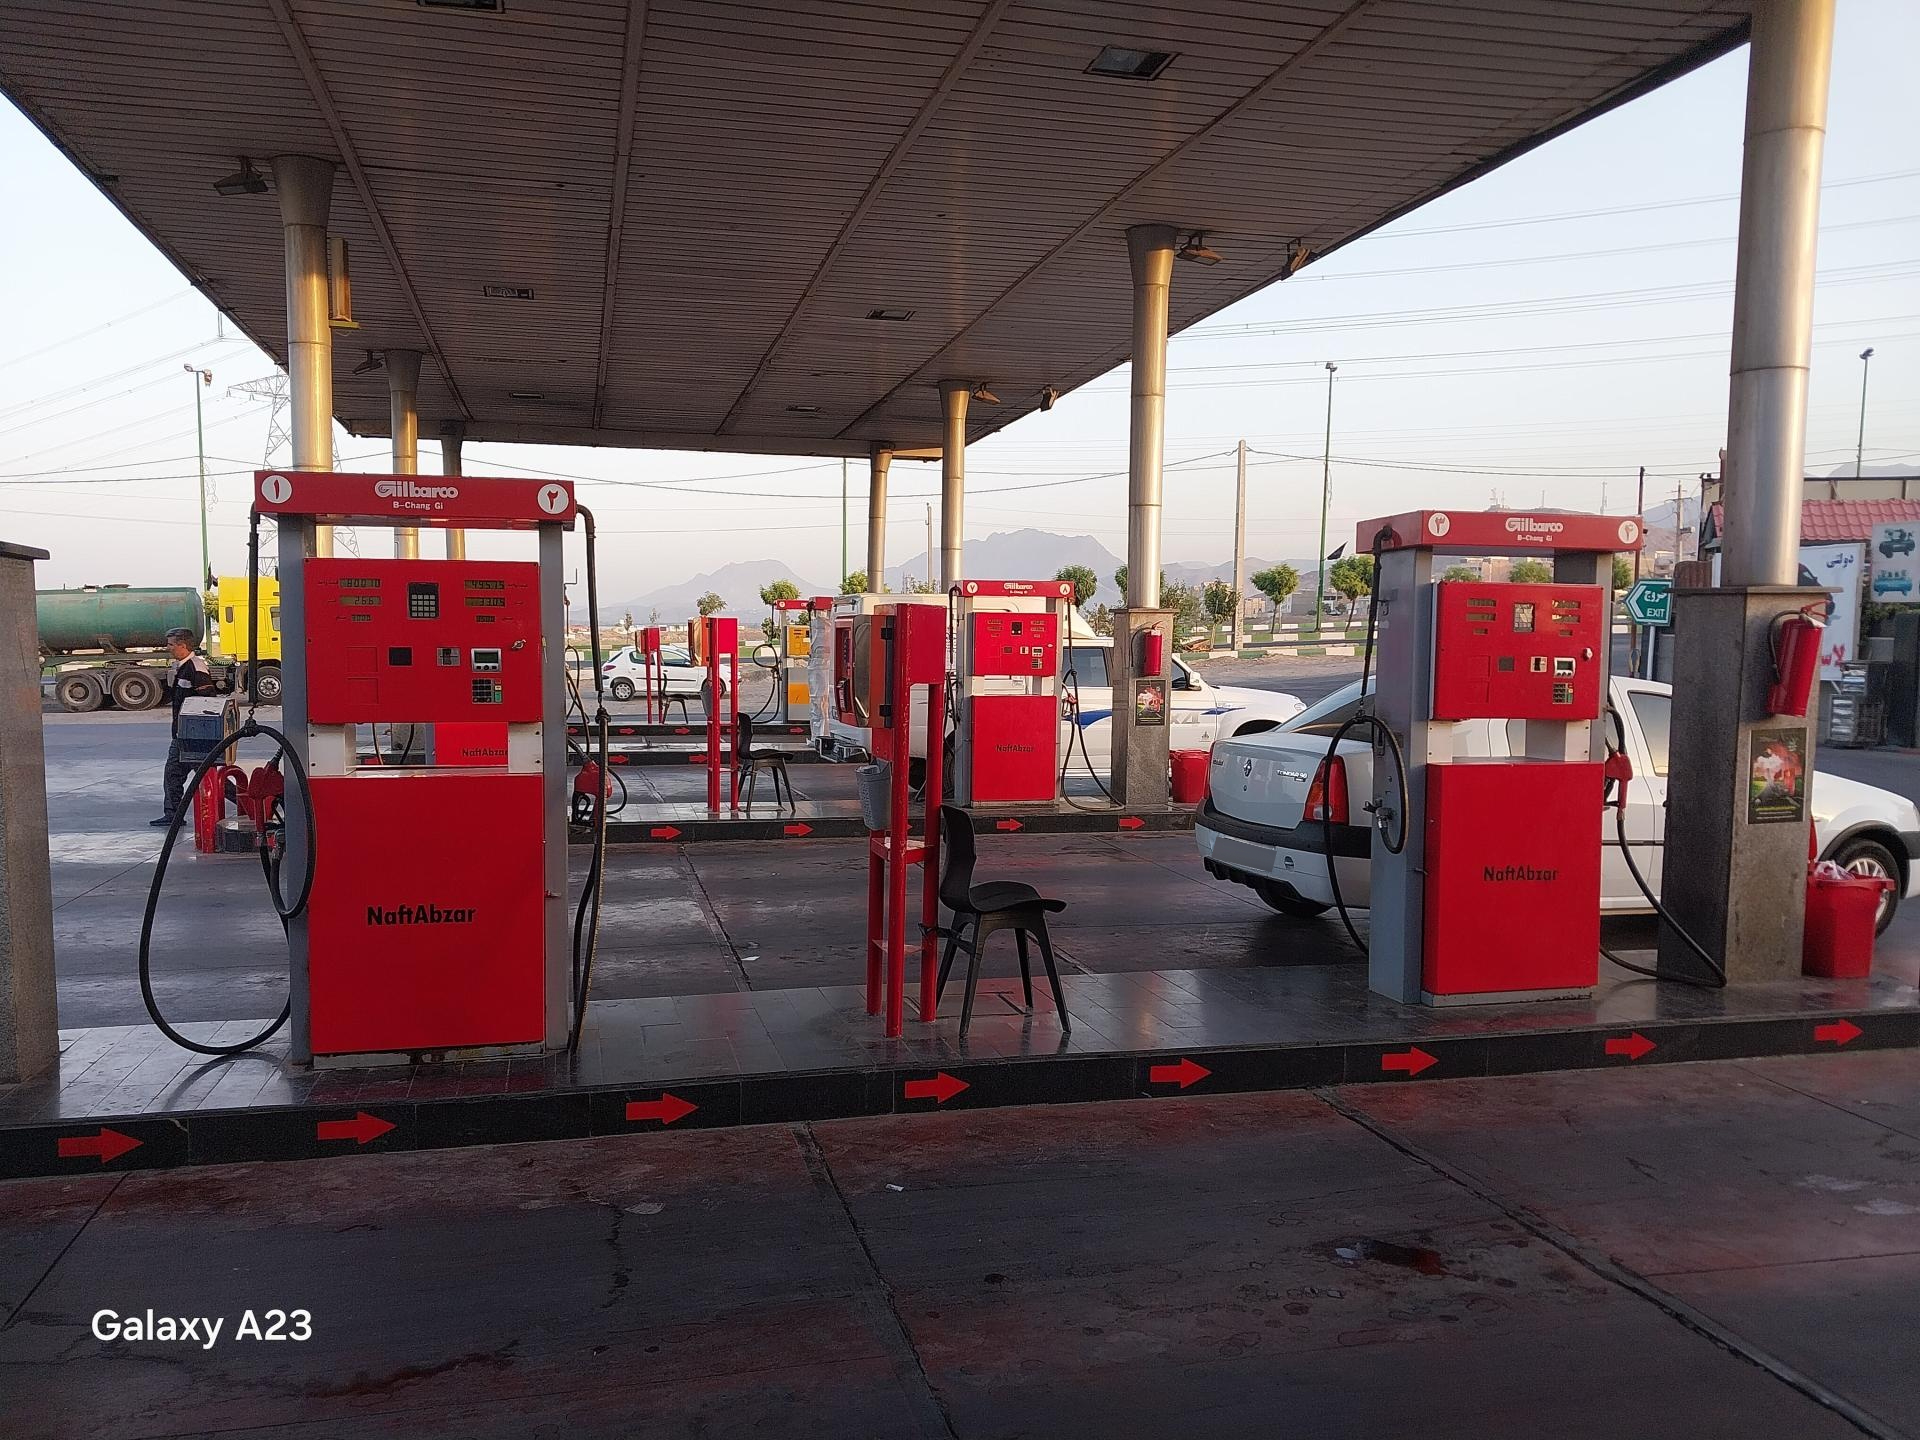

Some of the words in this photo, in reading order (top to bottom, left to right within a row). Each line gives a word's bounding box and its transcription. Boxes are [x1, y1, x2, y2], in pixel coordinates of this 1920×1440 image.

[375, 480, 459, 498] Gilbarco
[393, 501, 431, 510] B-Chang
[434, 502, 443, 510] Gi
[1505, 517, 1564, 533] Gilbarco
[1646, 608, 1666, 618] EXIT
[1483, 864, 1559, 881] NaftAbzar
[367, 903, 477, 925] NaftAbzar
